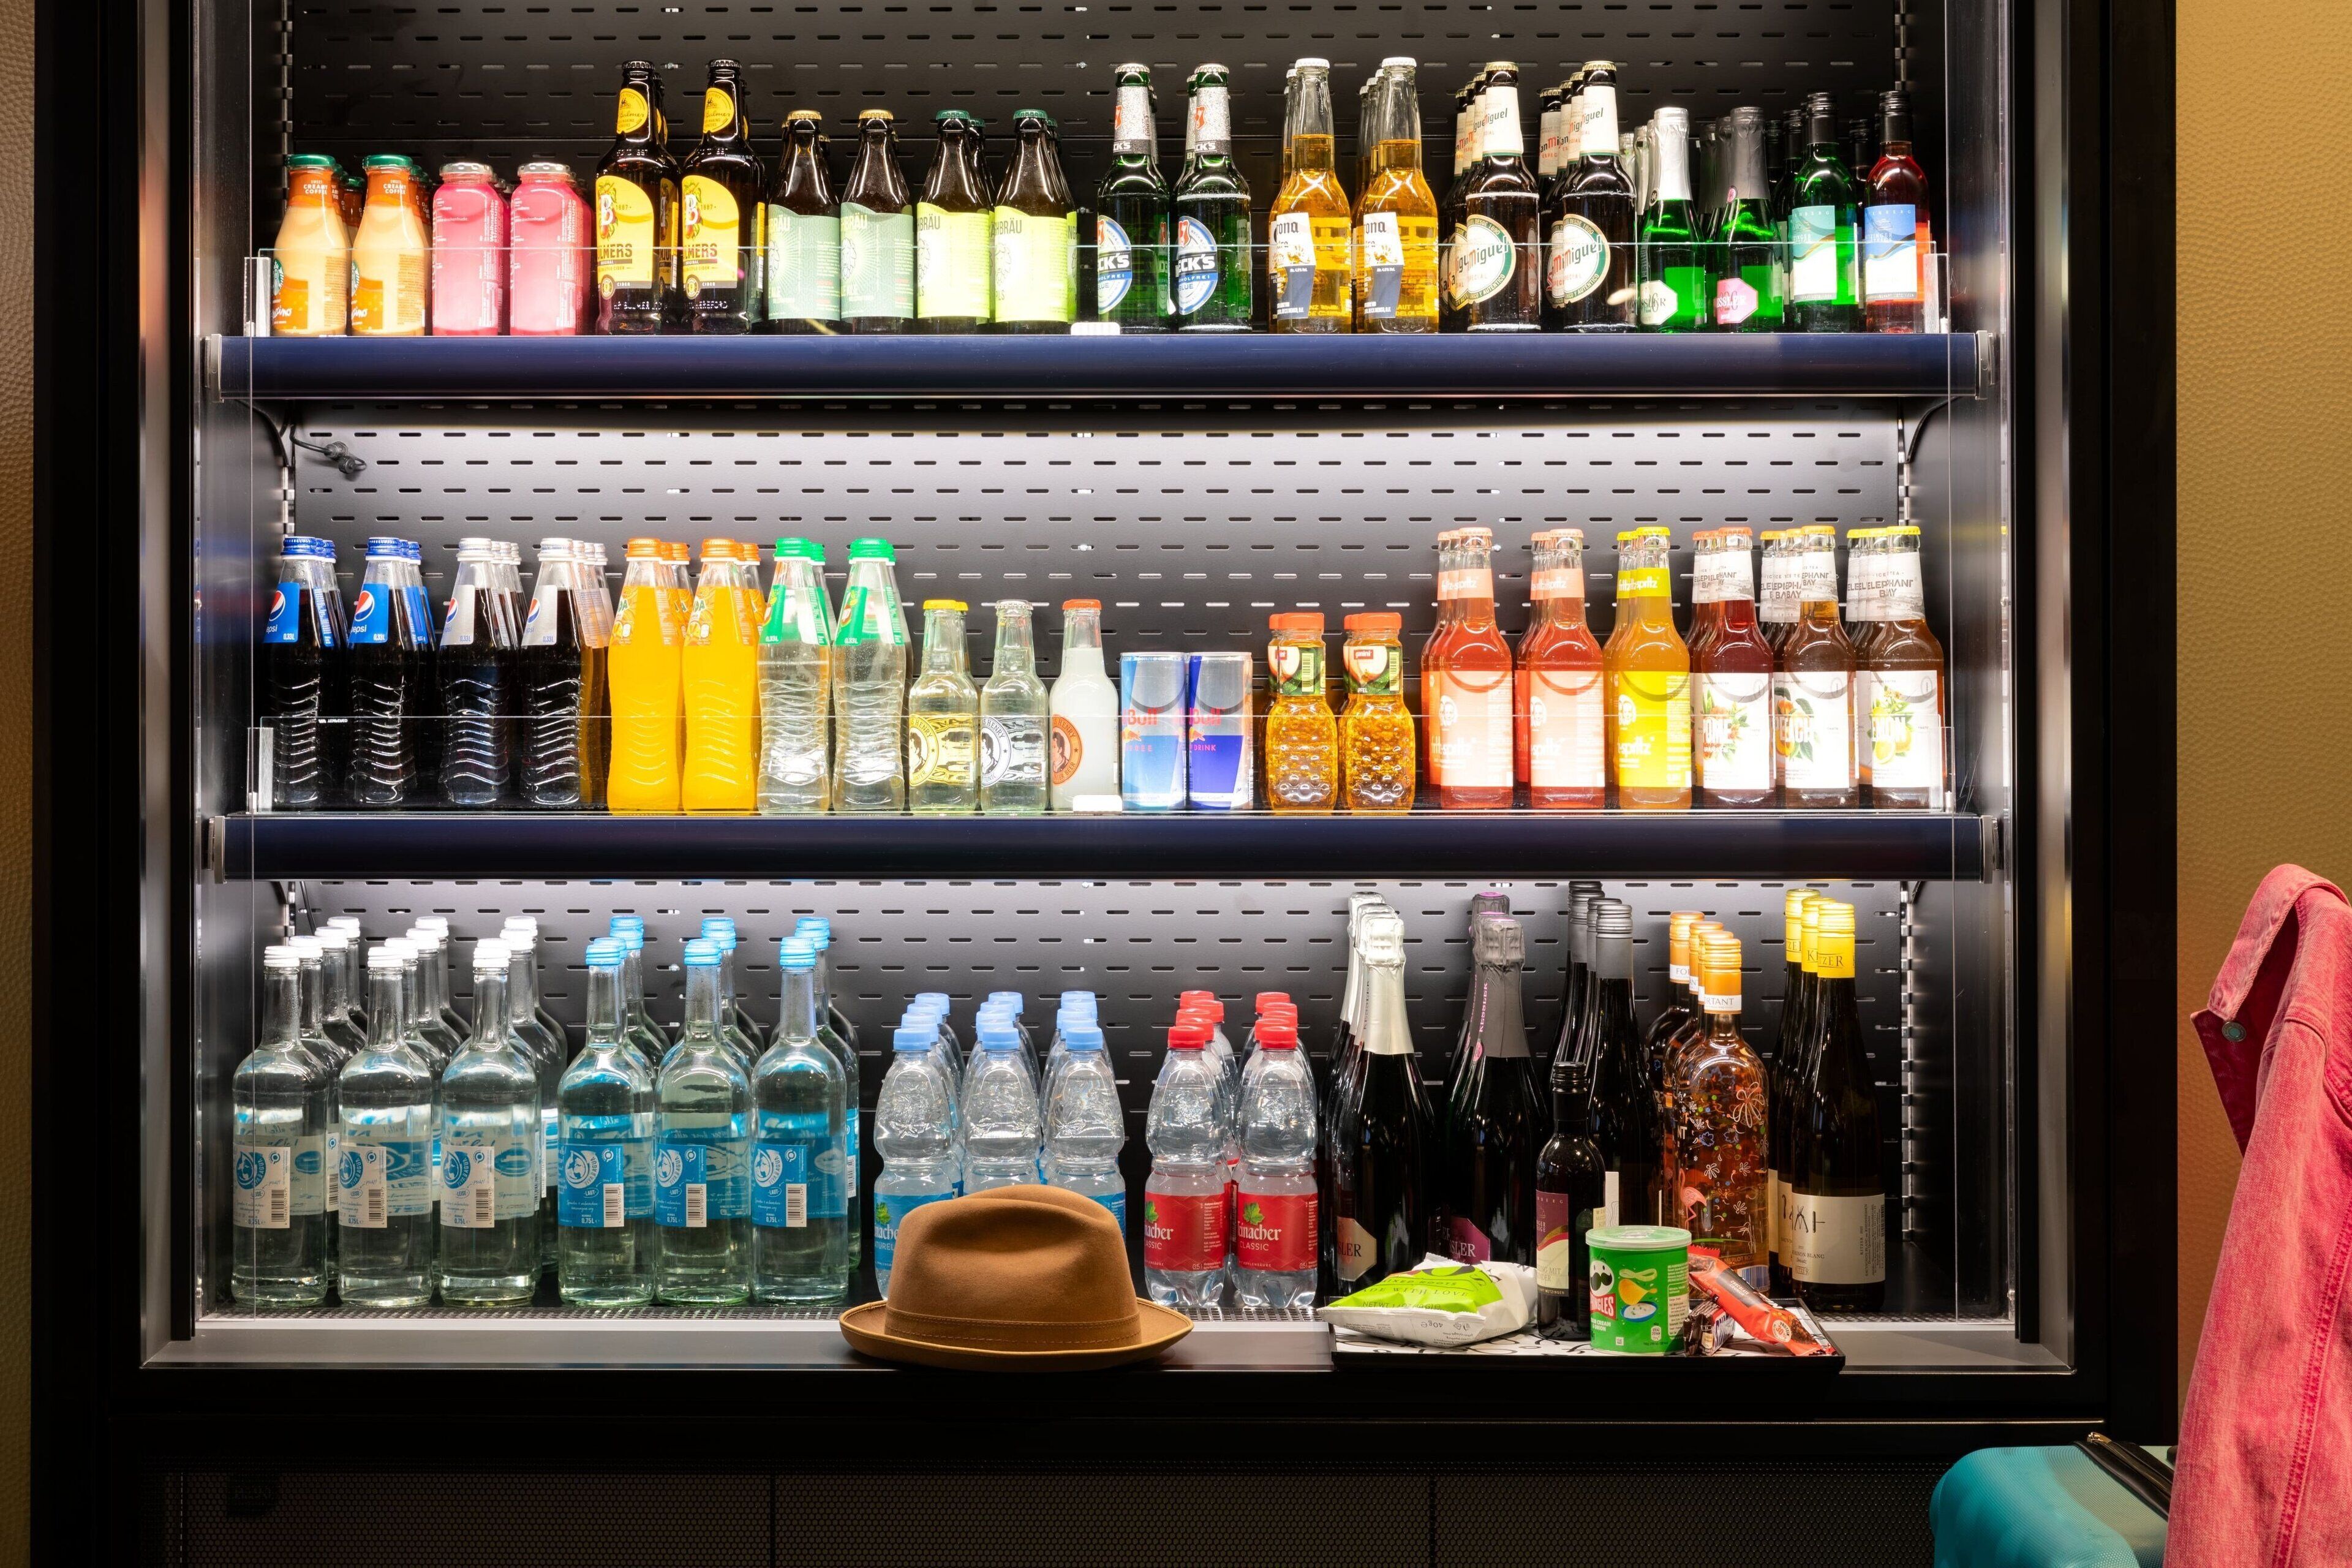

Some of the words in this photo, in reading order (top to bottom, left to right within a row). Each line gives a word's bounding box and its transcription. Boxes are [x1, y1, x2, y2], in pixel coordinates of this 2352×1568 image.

[1475, 219, 1487, 228] DESDE
[1488, 222, 1500, 236] 1890
[1569, 219, 1581, 227] DESDE
[1582, 222, 1594, 235] 1890
[1482, 274, 1505, 296] AUTENTICO
[1577, 274, 1600, 296] AUTENTICO
[1128, 708, 1157, 725] Bull
[1194, 708, 1221, 725] Bull
[915, 719, 932, 738] HENRY
[987, 718, 1005, 739] HENRY
[1058, 718, 1076, 738] HENRY
[1065, 761, 1076, 775] BEER
[1479, 982, 1488, 1033] KESSLER
[1240, 1241, 1269, 1251] CLASSIC
